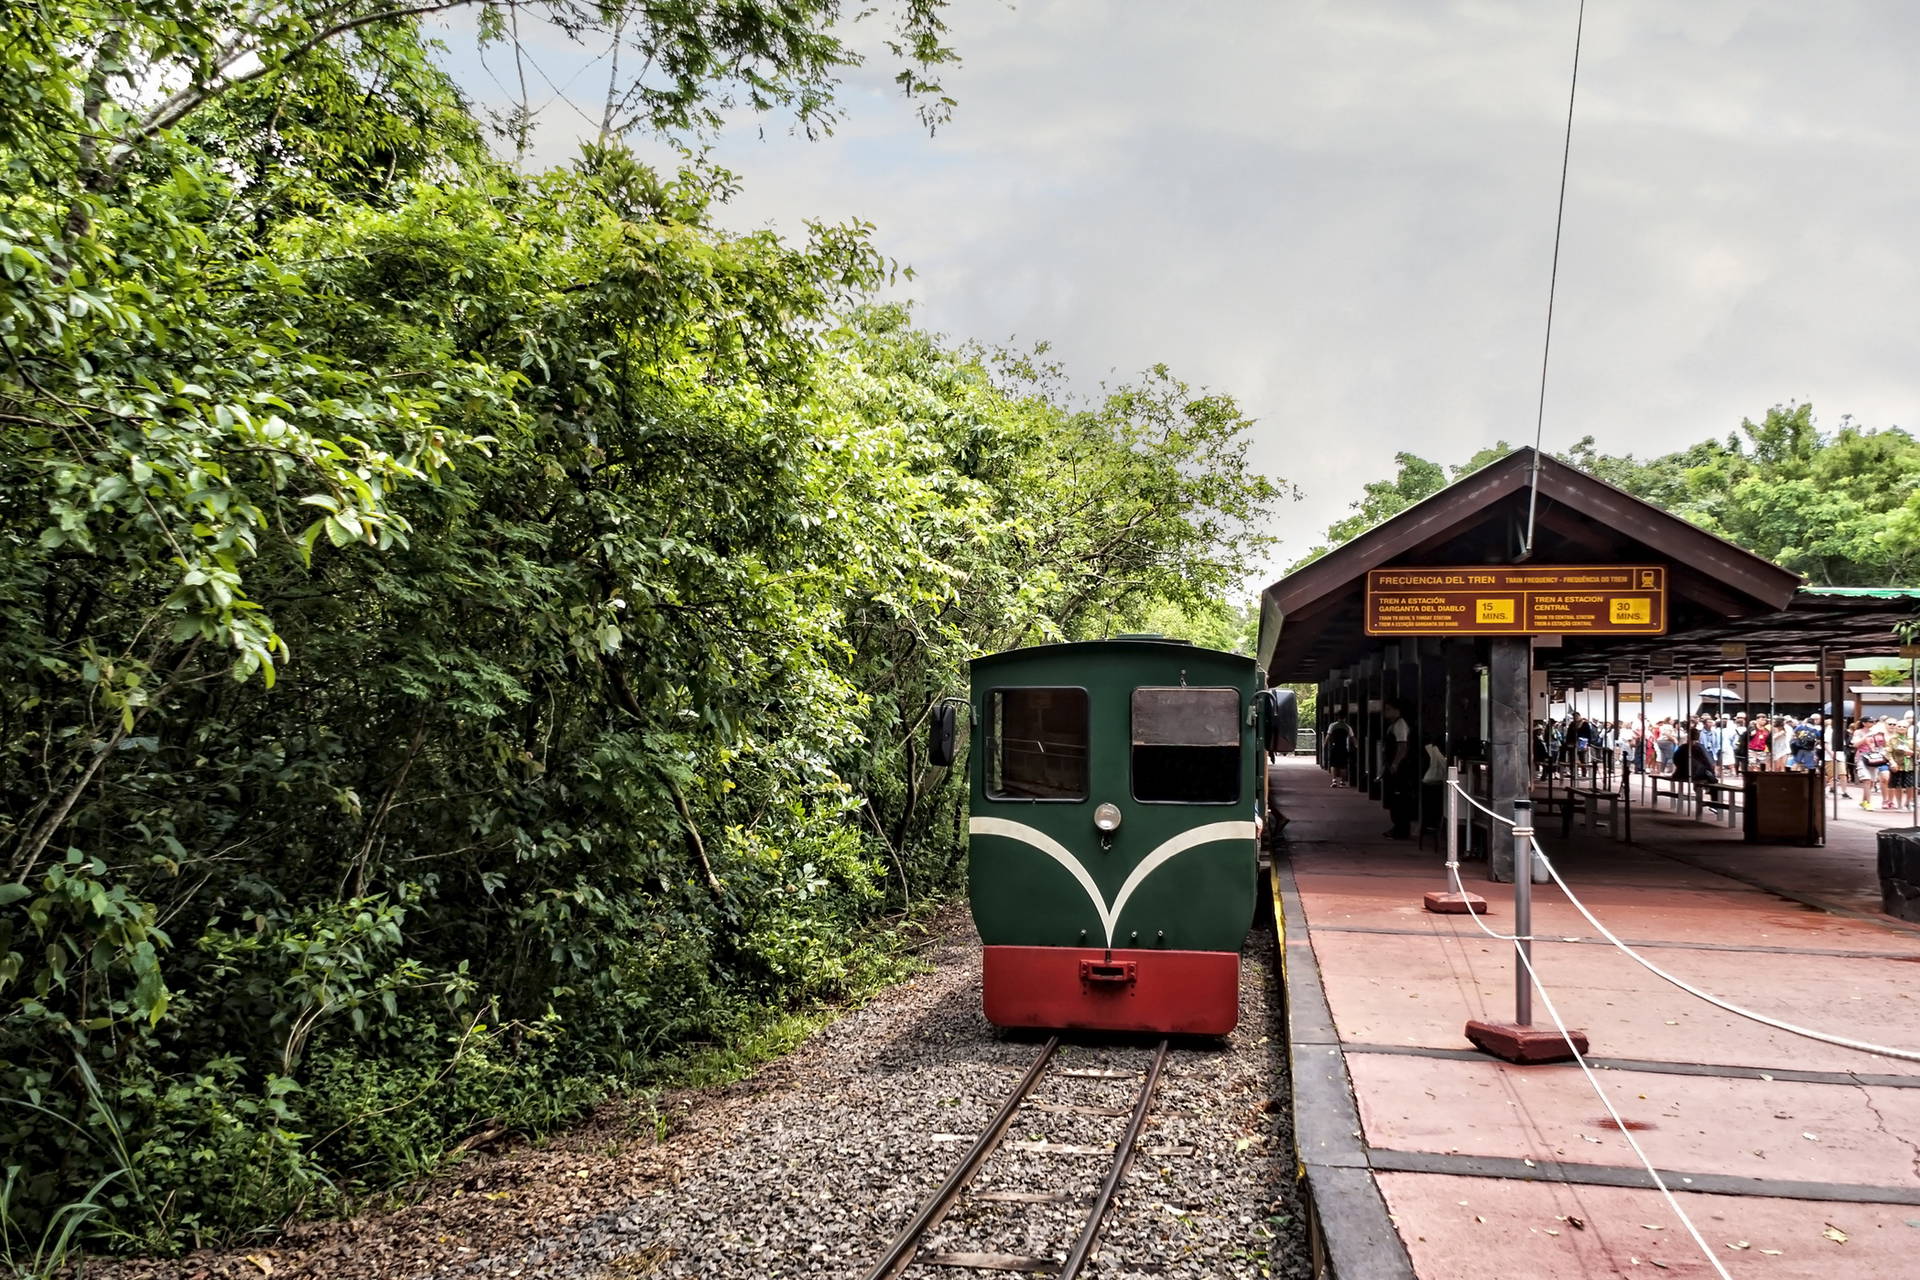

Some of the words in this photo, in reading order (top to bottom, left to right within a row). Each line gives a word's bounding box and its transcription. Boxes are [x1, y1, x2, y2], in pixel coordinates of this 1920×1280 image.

[1379, 576, 1443, 585] FRECUENCIA
[1445, 576, 1465, 584] DEL
[1467, 575, 1496, 584] TREN
[1482, 603, 1493, 611] 15
[1616, 602, 1631, 611] 30
